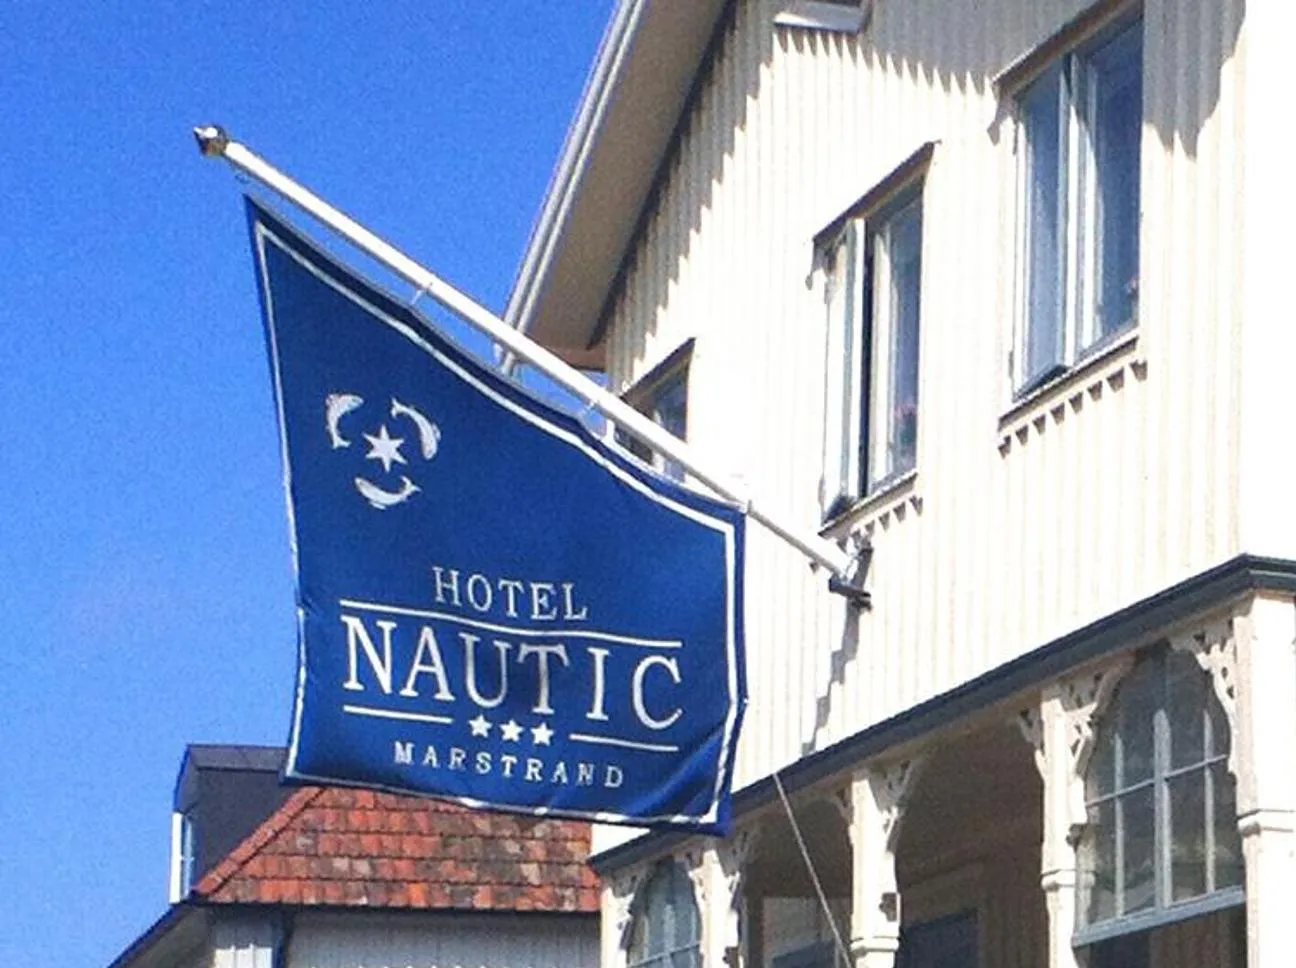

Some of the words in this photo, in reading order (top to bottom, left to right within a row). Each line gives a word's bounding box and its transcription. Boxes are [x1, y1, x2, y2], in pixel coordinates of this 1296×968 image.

[431, 565, 589, 621] HOTEL
[339, 613, 684, 730] NAUTIC
[393, 740, 625, 789] MARSTRAND
